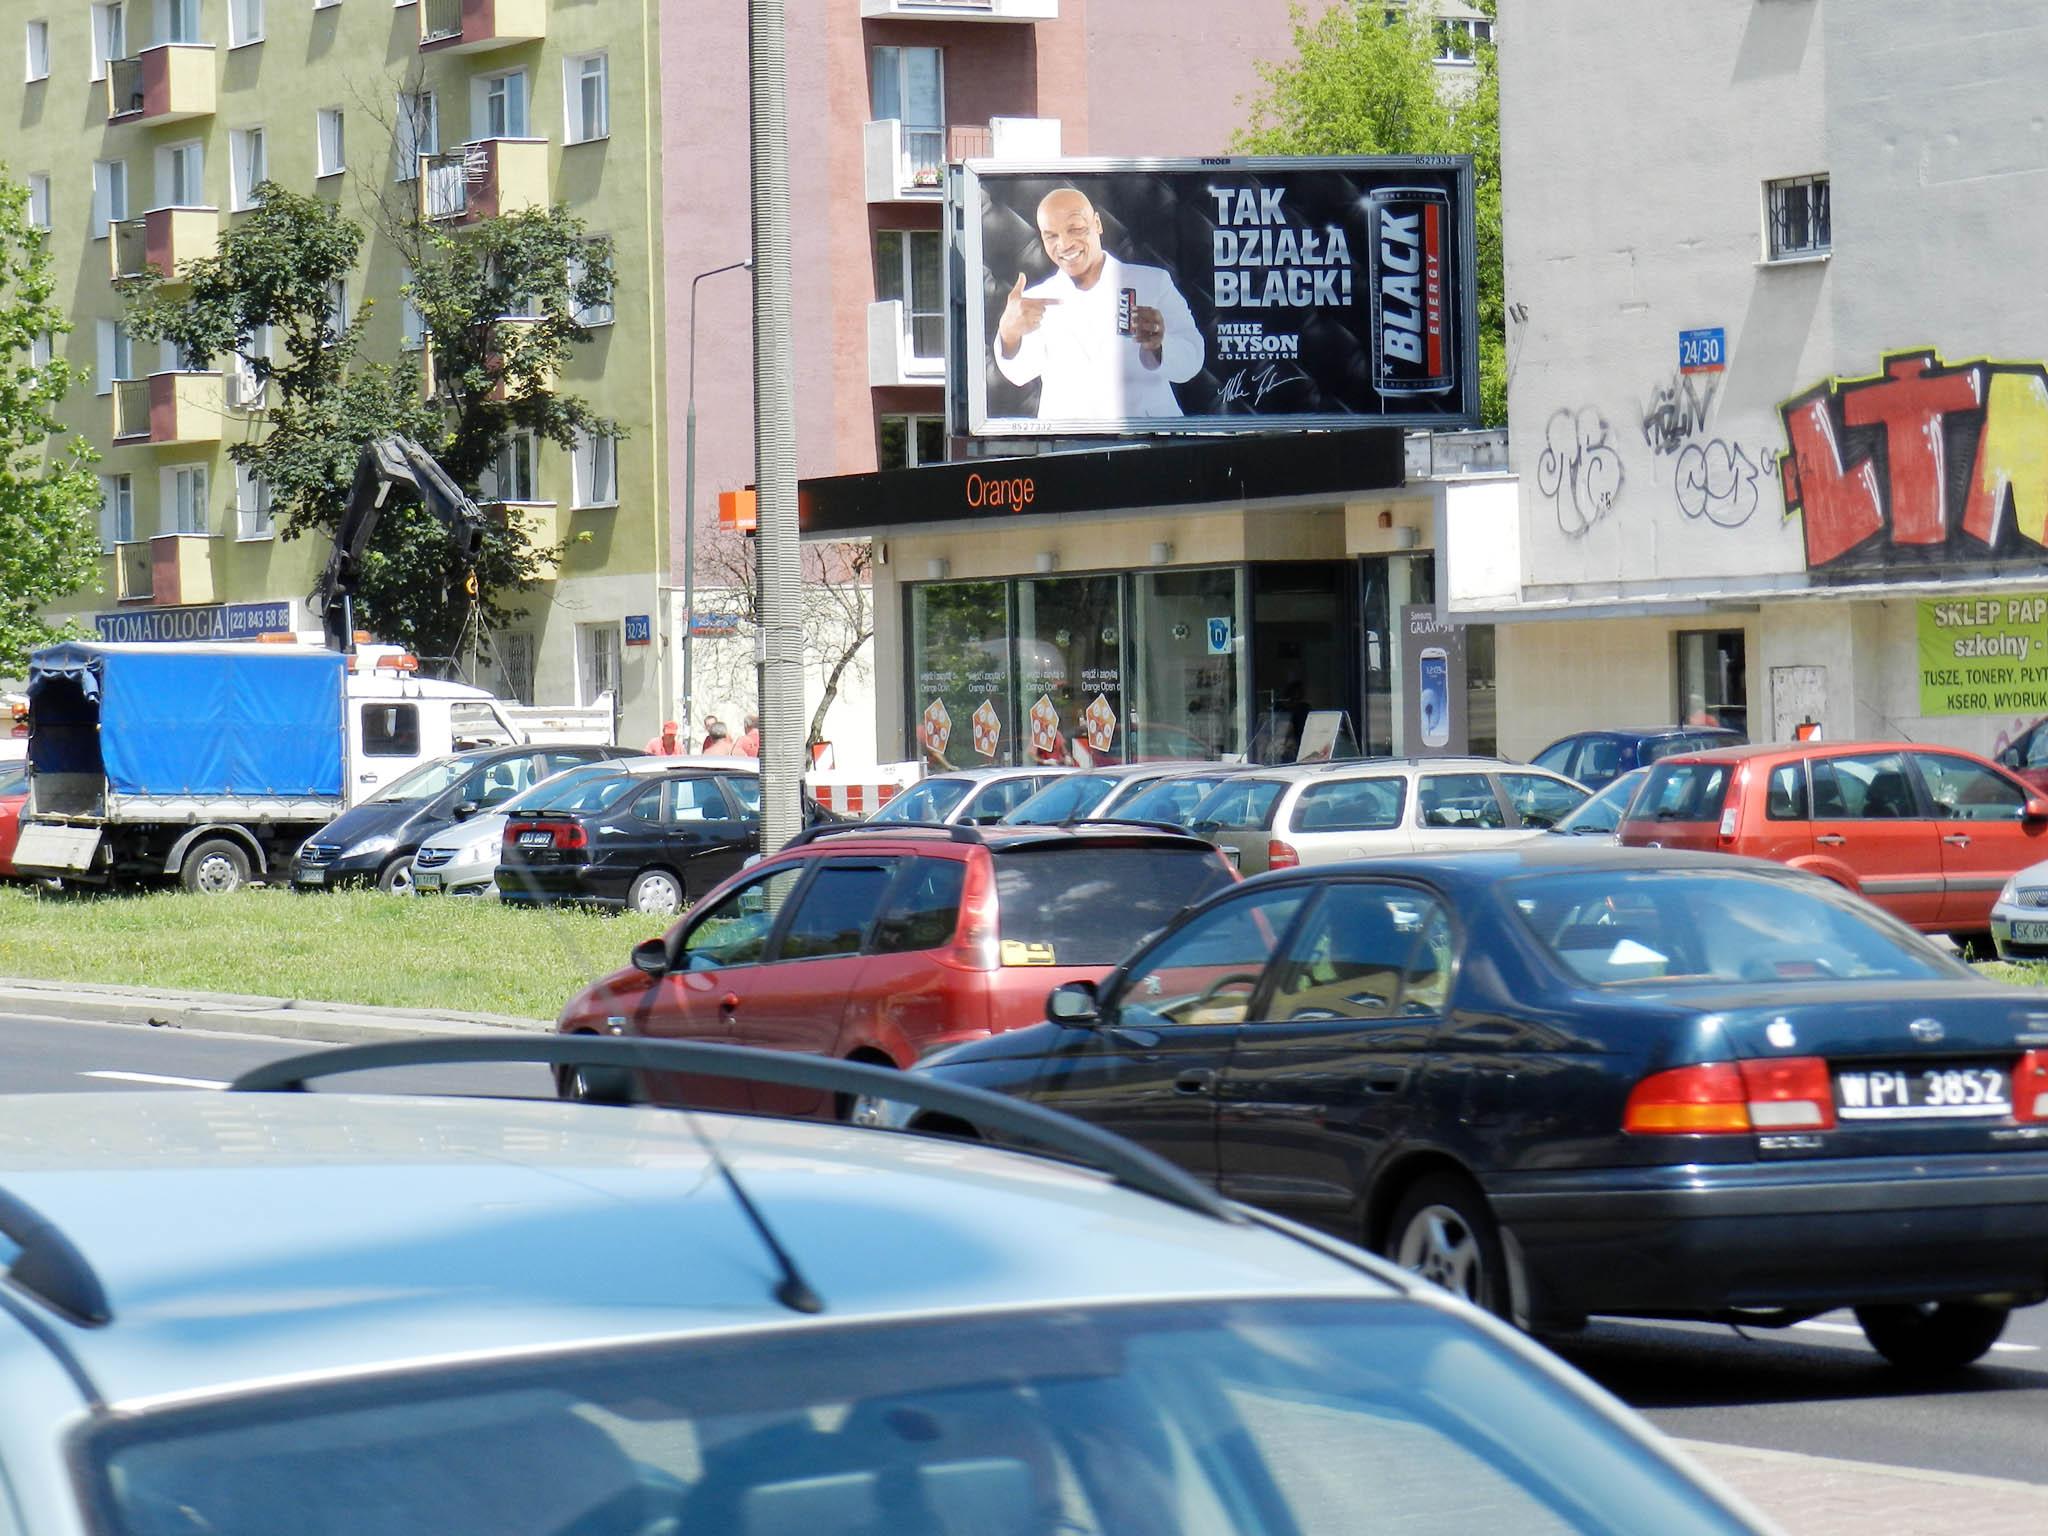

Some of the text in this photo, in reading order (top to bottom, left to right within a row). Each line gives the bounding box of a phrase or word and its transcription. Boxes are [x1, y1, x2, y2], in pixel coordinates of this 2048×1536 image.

[1211, 187, 1287, 226] TAK
[1213, 228, 1352, 267] DZIAŁA
[1213, 269, 1353, 308] BLACK!
[1381, 208, 1423, 364] BLACK
[1428, 254, 1440, 335] ENERGY
[1118, 292, 1131, 331] BLACK
[1217, 323, 1263, 336] MIKE
[1217, 334, 1299, 353] TYSON
[1217, 352, 1299, 361] COLLECTION
[1683, 338, 1719, 366] 24/30
[966, 472, 1036, 513] Orange
[98, 604, 289, 643] STOMATOLOGIA (22) 843 58 85
[1935, 600, 2001, 627] SKLEP
[1954, 631, 2029, 661] szkolny
[1923, 670, 1963, 687] TUSZE,
[1966, 668, 2017, 685] TONERY,
[1947, 693, 1990, 710] KSERO,
[2016, 923, 2030, 939] SK
[1839, 1068, 2005, 1107] WPI 3852
